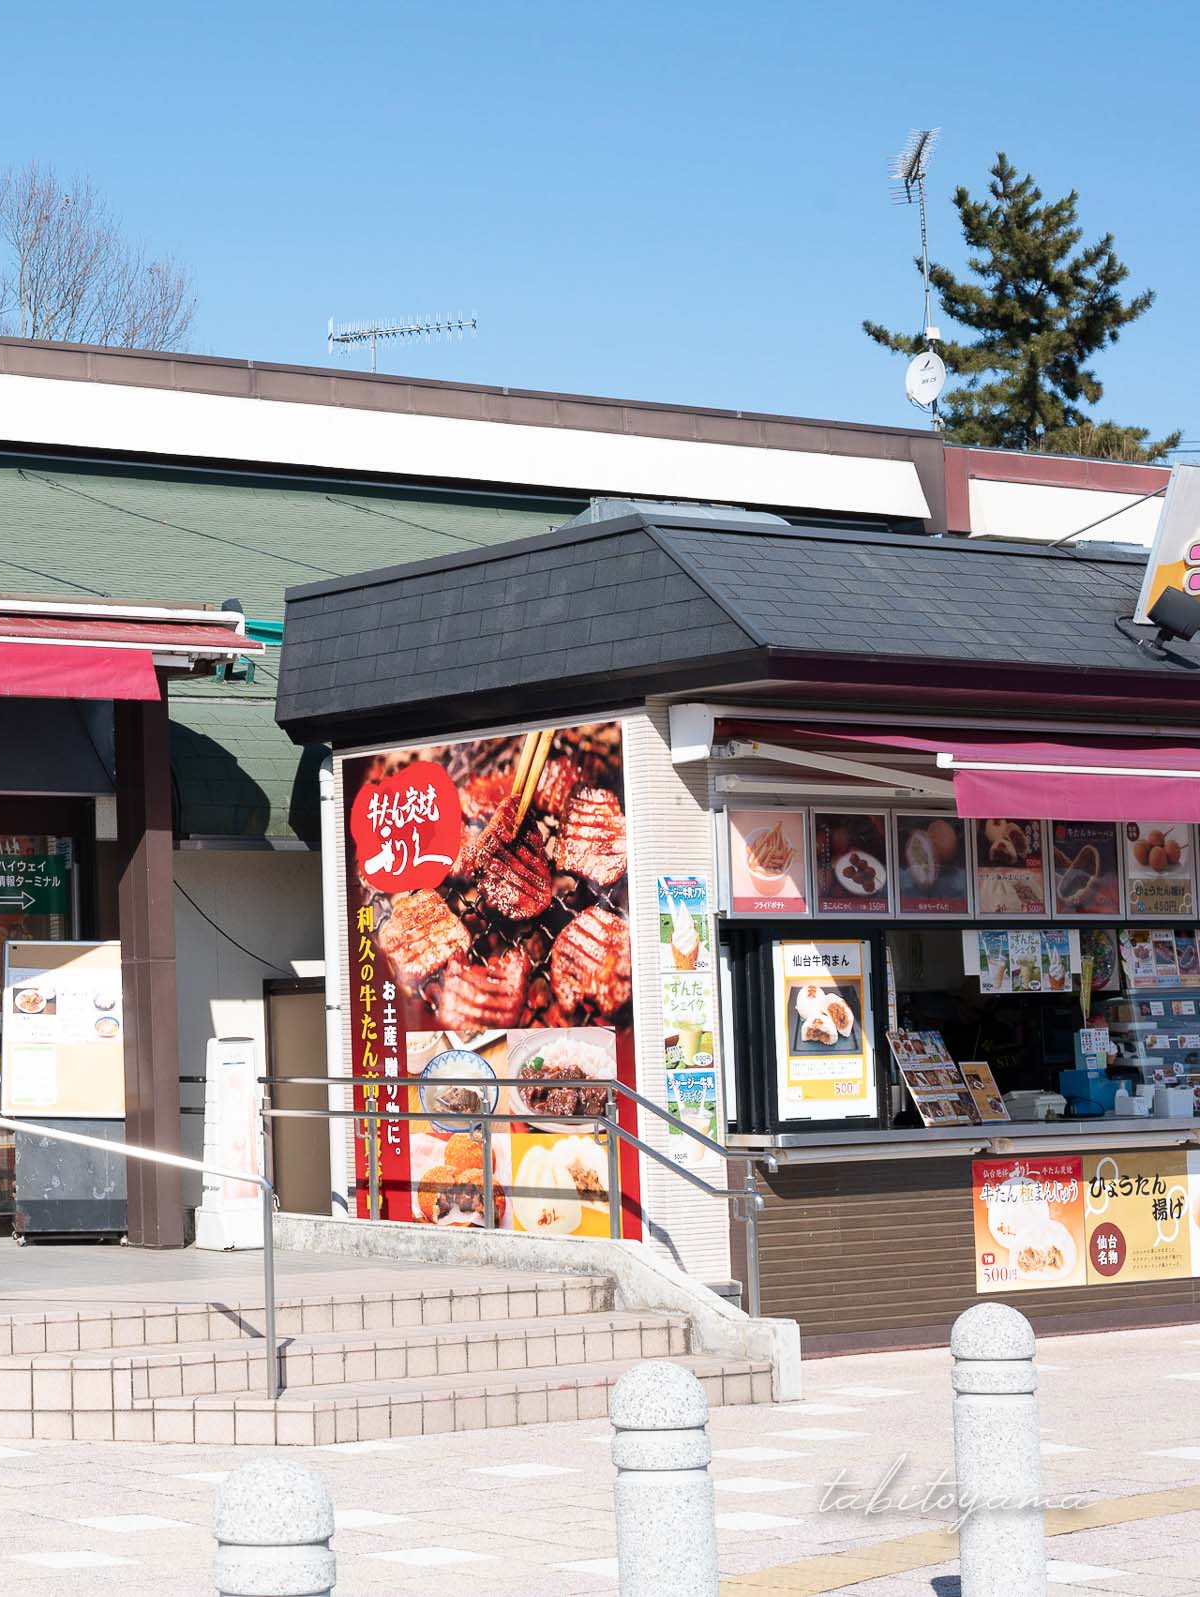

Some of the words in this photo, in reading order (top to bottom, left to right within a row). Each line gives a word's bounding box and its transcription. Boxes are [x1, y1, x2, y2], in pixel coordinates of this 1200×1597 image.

[793, 954, 850, 967] 仙台牛肉まん
[670, 980, 704, 997] ずんだ
[1088, 1172, 1167, 1199] ひょうたん
[1151, 1196, 1185, 1222] 揚げ
[1097, 1234, 1118, 1250] 仙台
[1098, 1250, 1119, 1265] 名物
